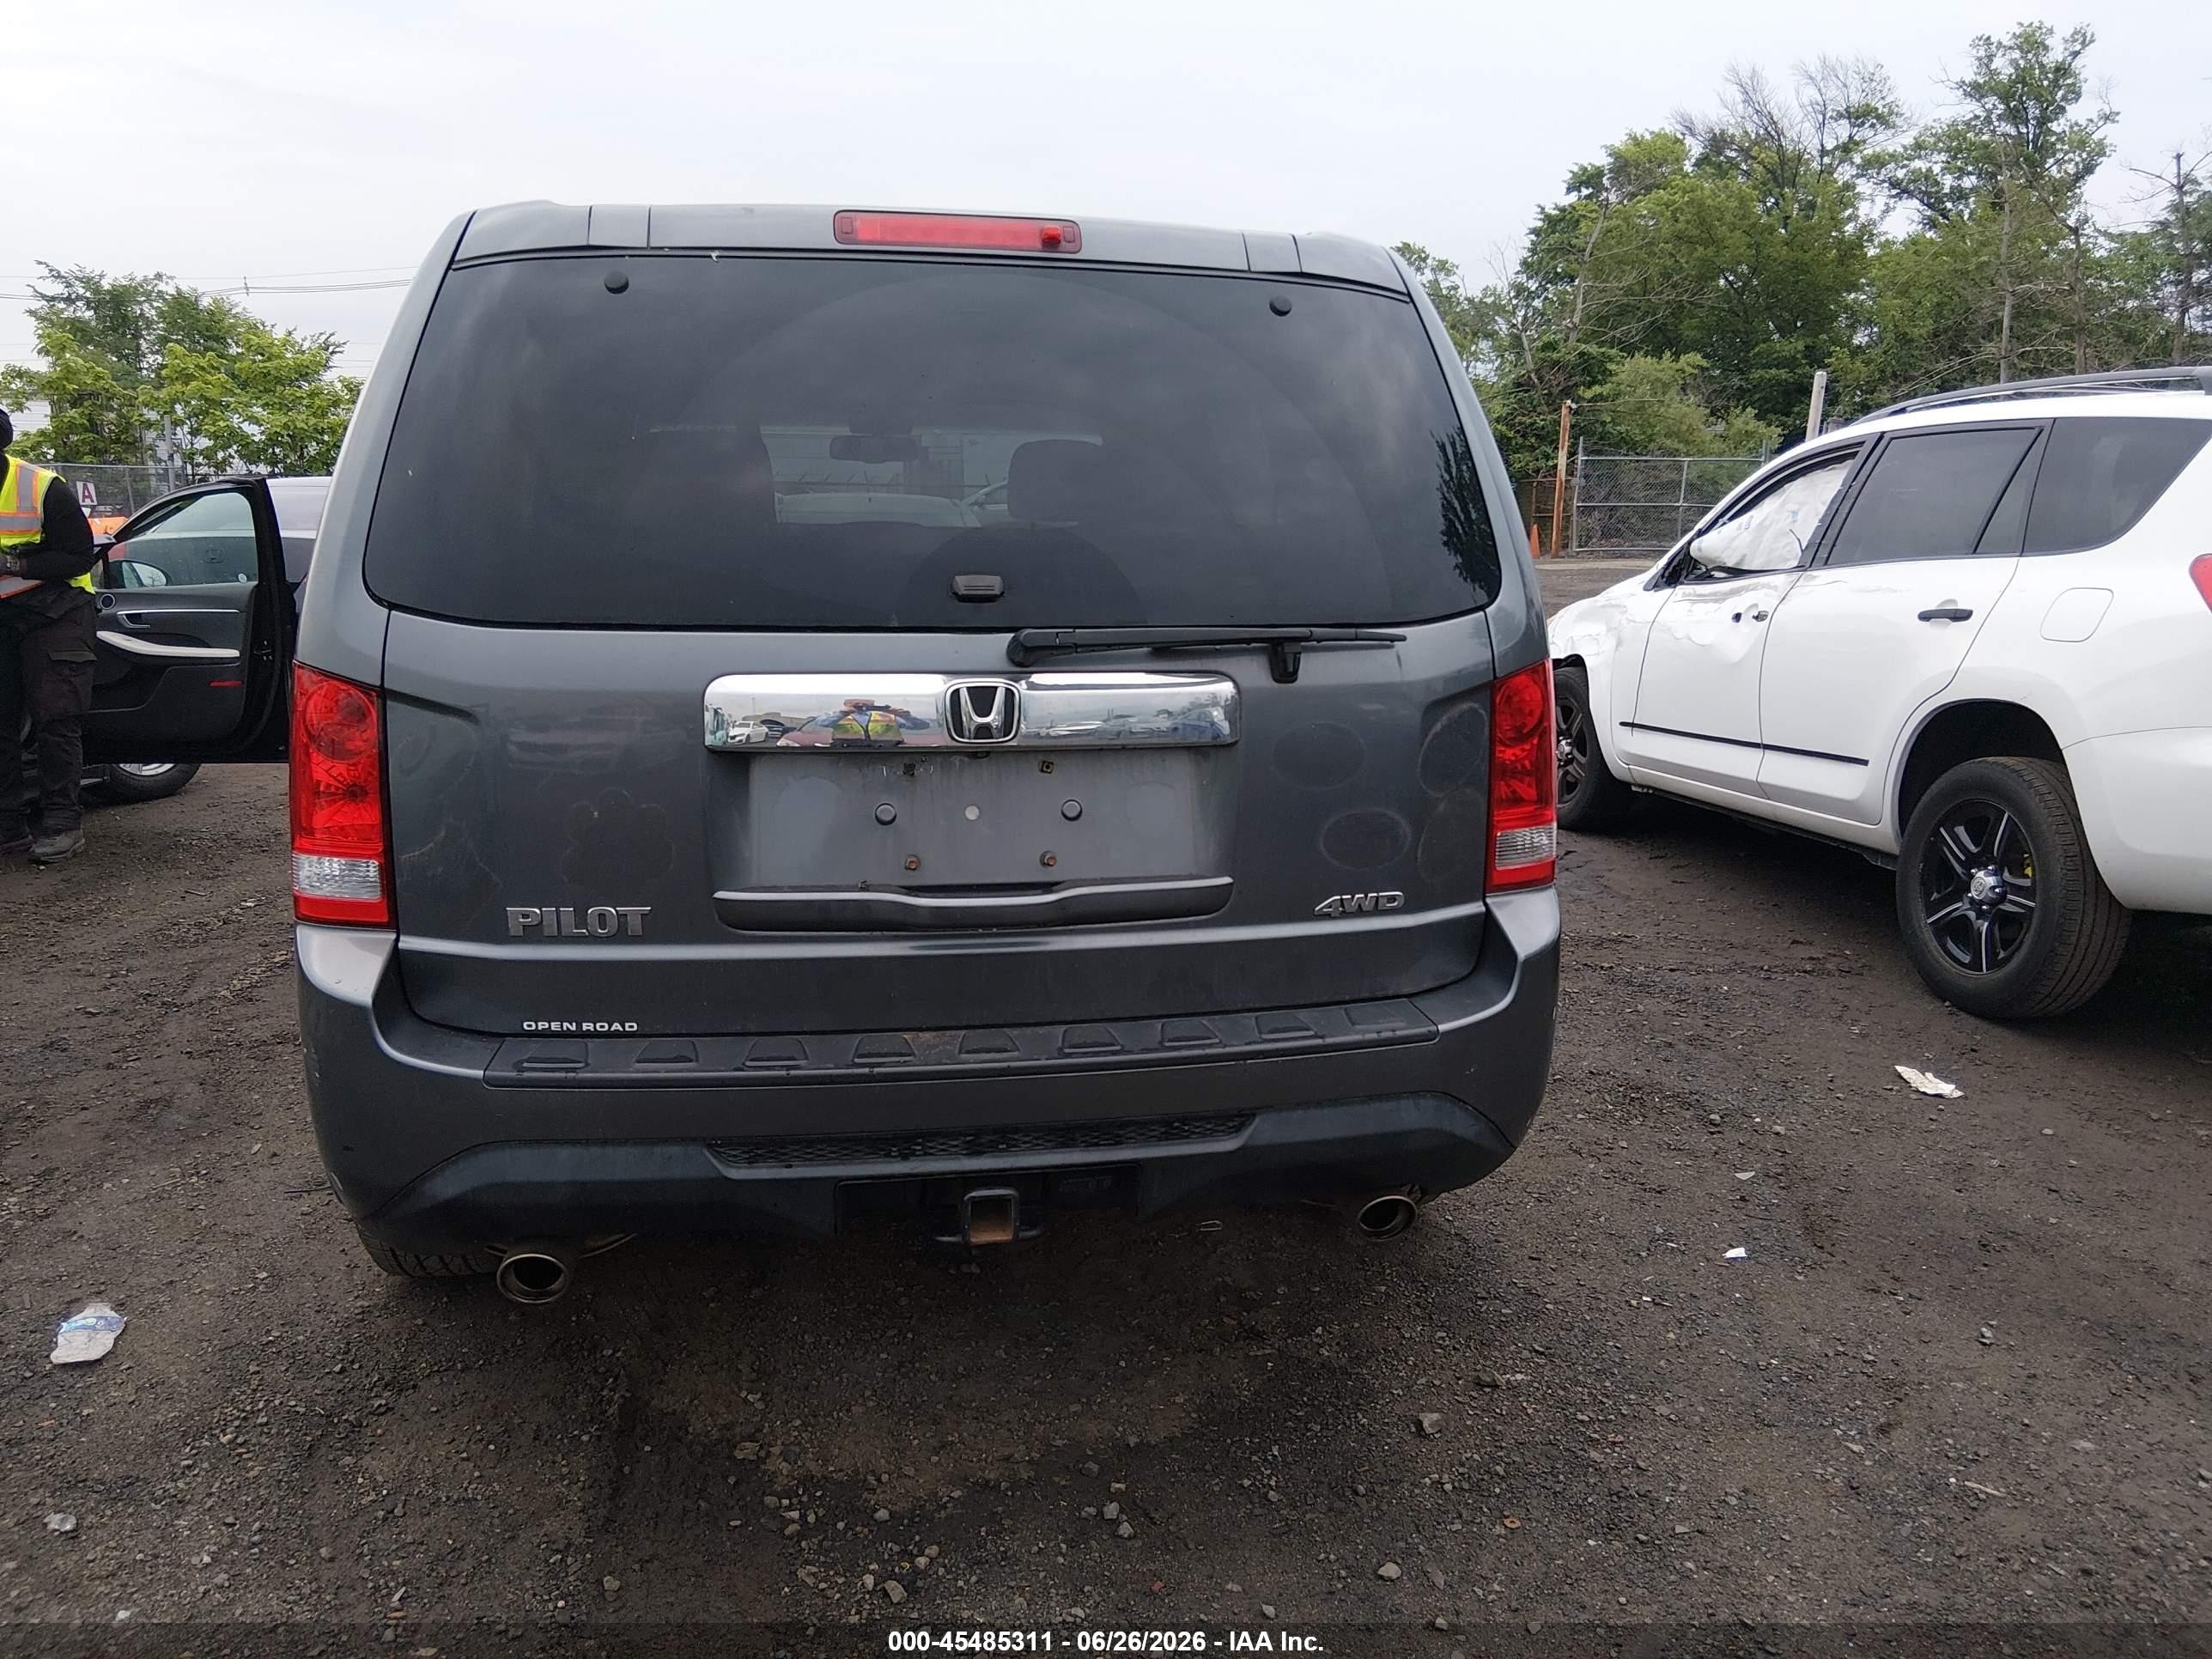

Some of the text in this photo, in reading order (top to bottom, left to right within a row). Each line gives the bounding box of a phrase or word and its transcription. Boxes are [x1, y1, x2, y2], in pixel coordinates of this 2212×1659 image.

[82, 483, 94, 503] A
[1314, 891, 1404, 916] 4WD
[506, 906, 651, 937] PILOT
[522, 1021, 638, 1031] OPEN ROAD
